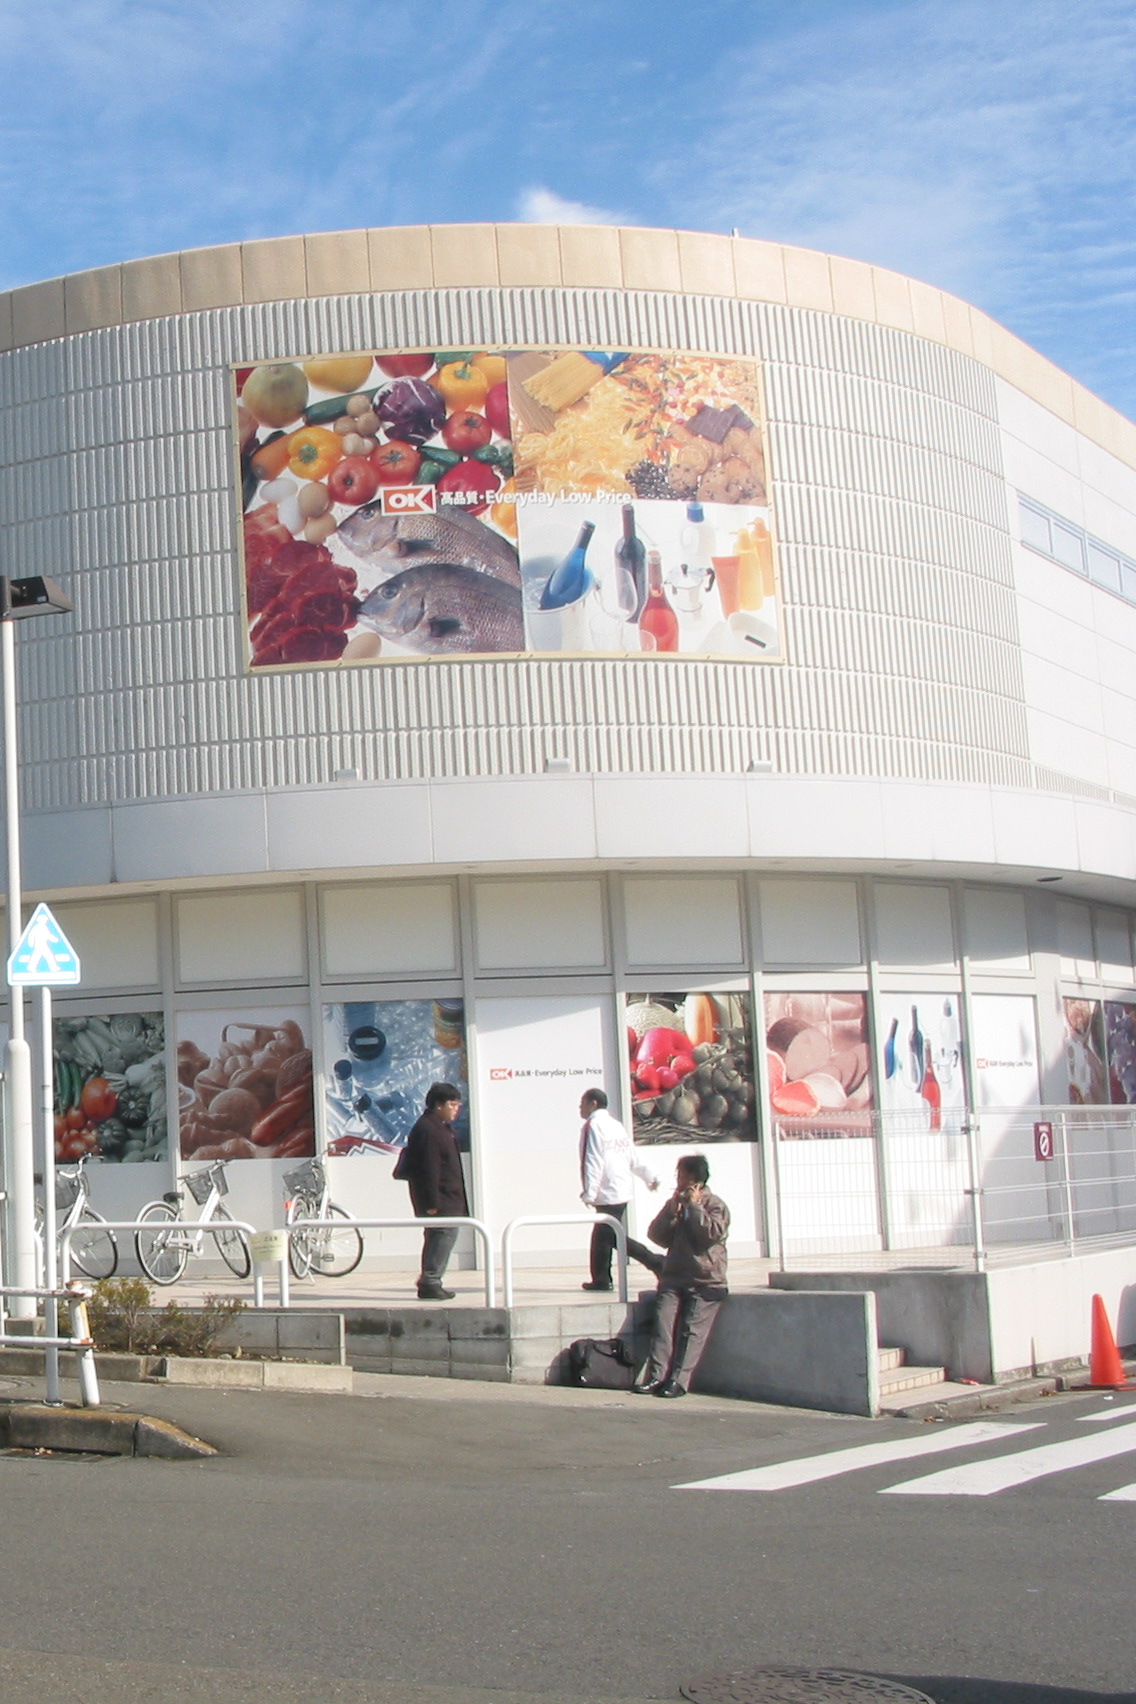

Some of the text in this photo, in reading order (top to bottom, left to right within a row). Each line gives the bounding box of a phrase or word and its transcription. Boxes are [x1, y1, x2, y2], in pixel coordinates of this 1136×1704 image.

[389, 487, 435, 513] OK
[486, 489, 556, 507] Everyday
[560, 489, 593, 505] Low
[597, 489, 633, 505] Price
